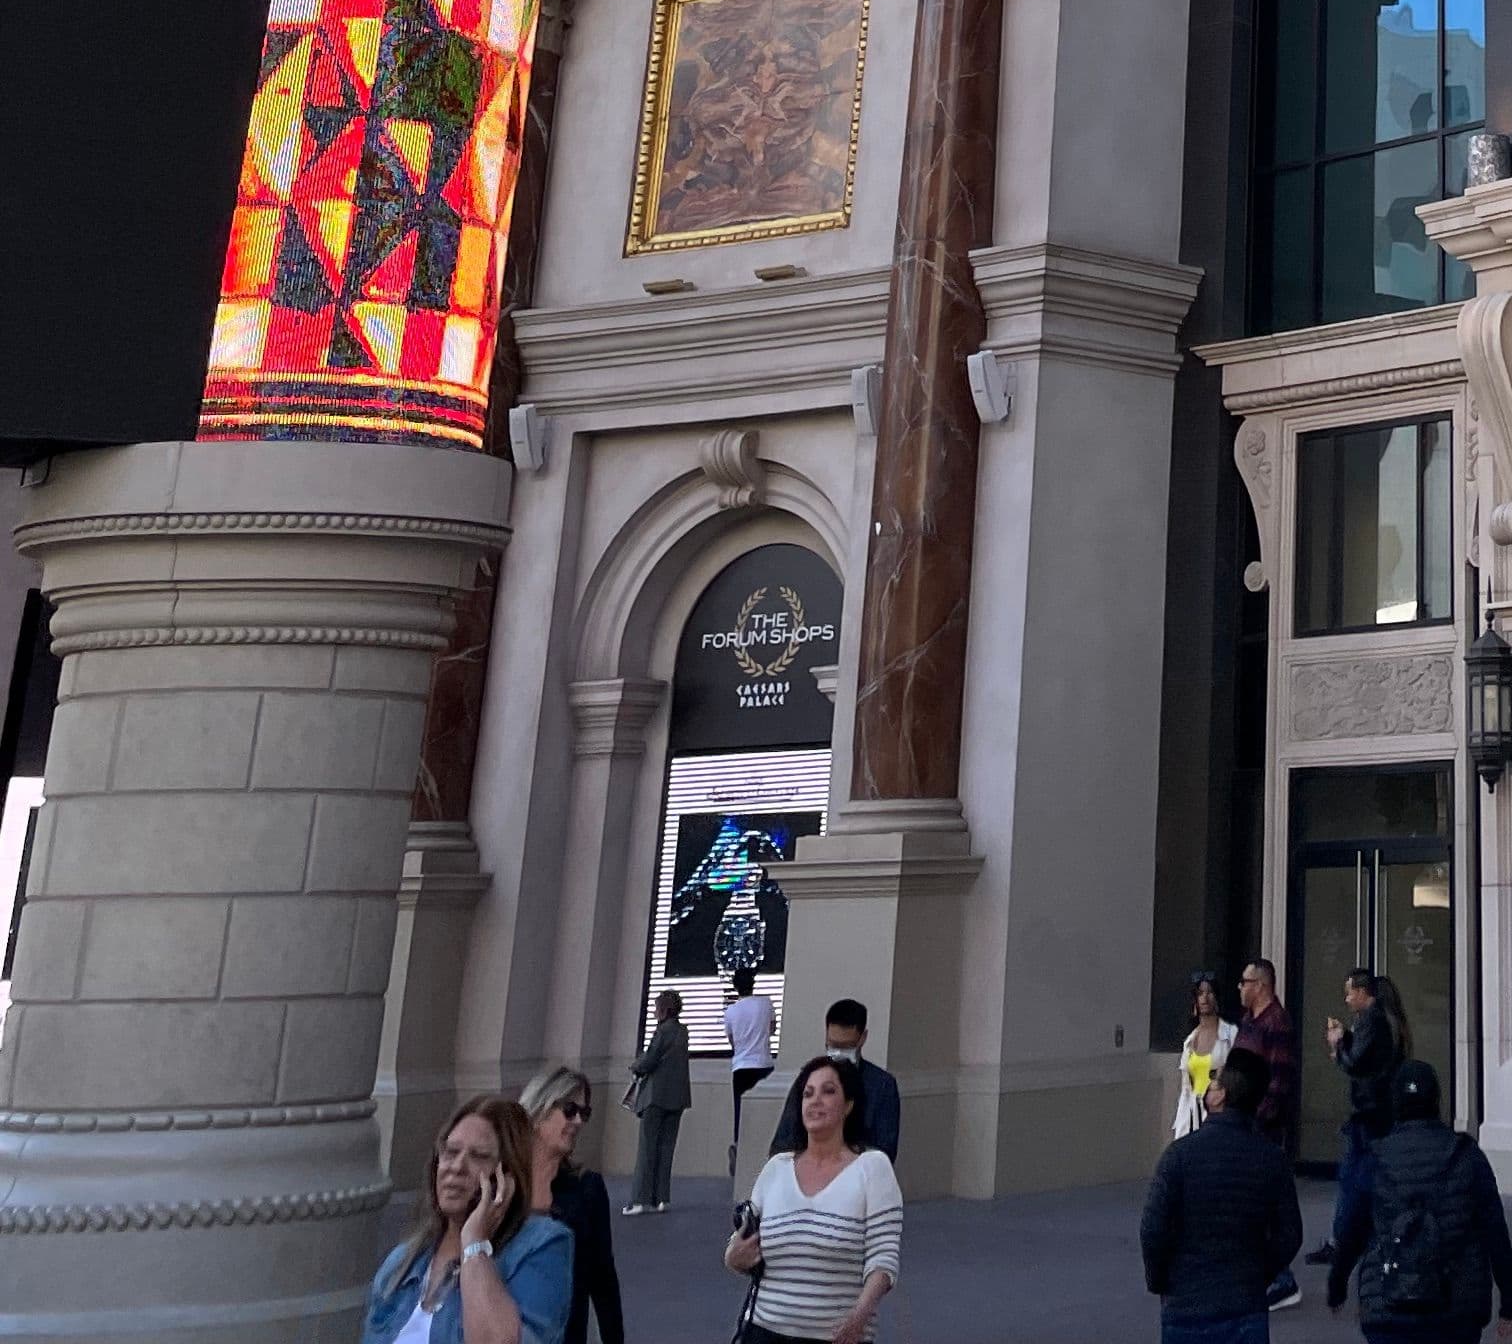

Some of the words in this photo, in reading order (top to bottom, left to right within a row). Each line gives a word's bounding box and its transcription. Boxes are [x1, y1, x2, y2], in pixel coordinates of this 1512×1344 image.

[752, 612, 788, 629] THE
[702, 630, 766, 648] FORUM
[769, 625, 834, 643] SHOPS
[736, 682, 790, 696] CAESARS
[739, 695, 785, 708] PALACE
